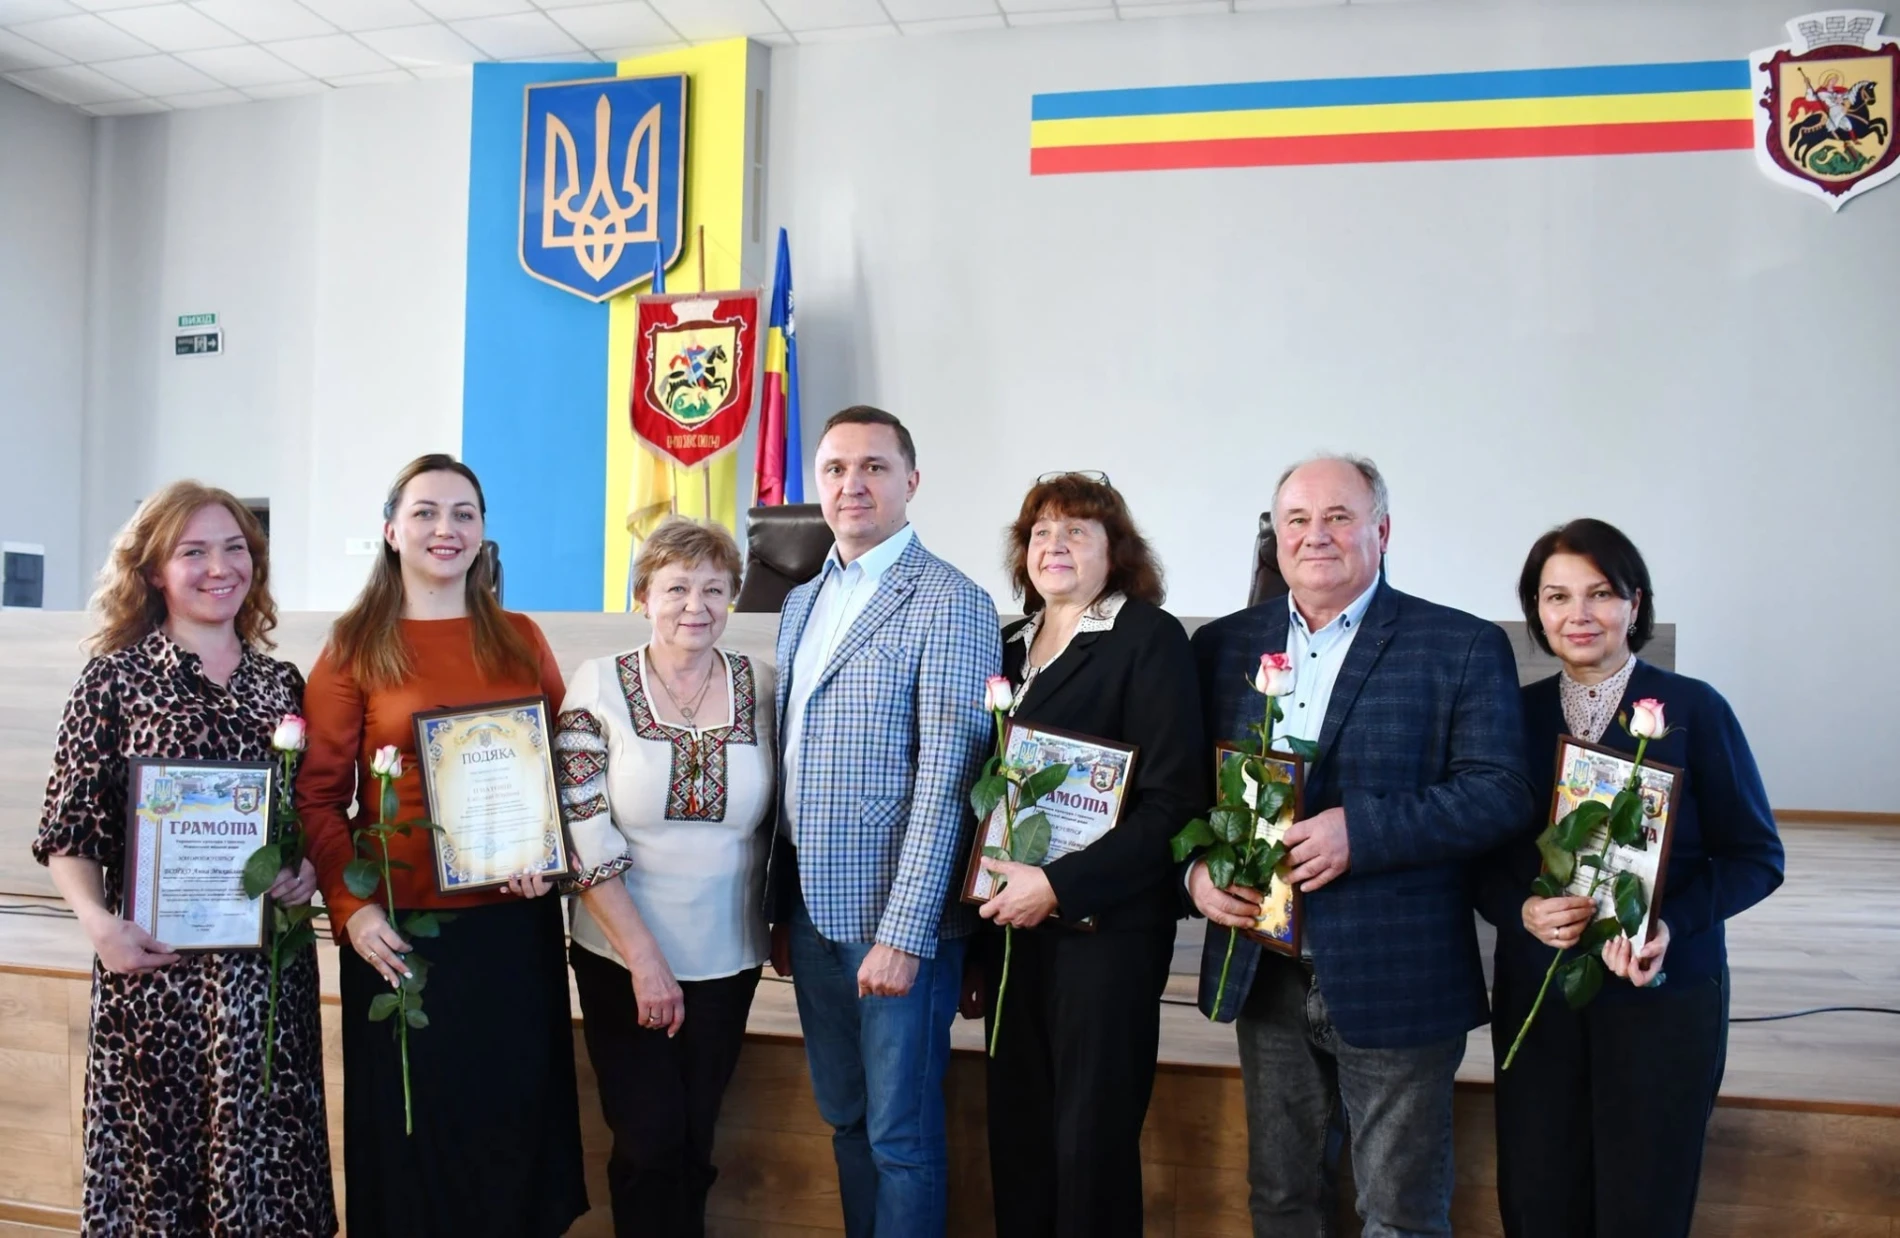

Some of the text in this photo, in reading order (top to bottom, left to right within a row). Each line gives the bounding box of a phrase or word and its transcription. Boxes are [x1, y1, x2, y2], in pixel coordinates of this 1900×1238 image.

[462, 748, 516, 765] ПОДЯКА
[1045, 790, 1109, 815] АМОТА
[169, 820, 258, 836] ГРАМОТА
